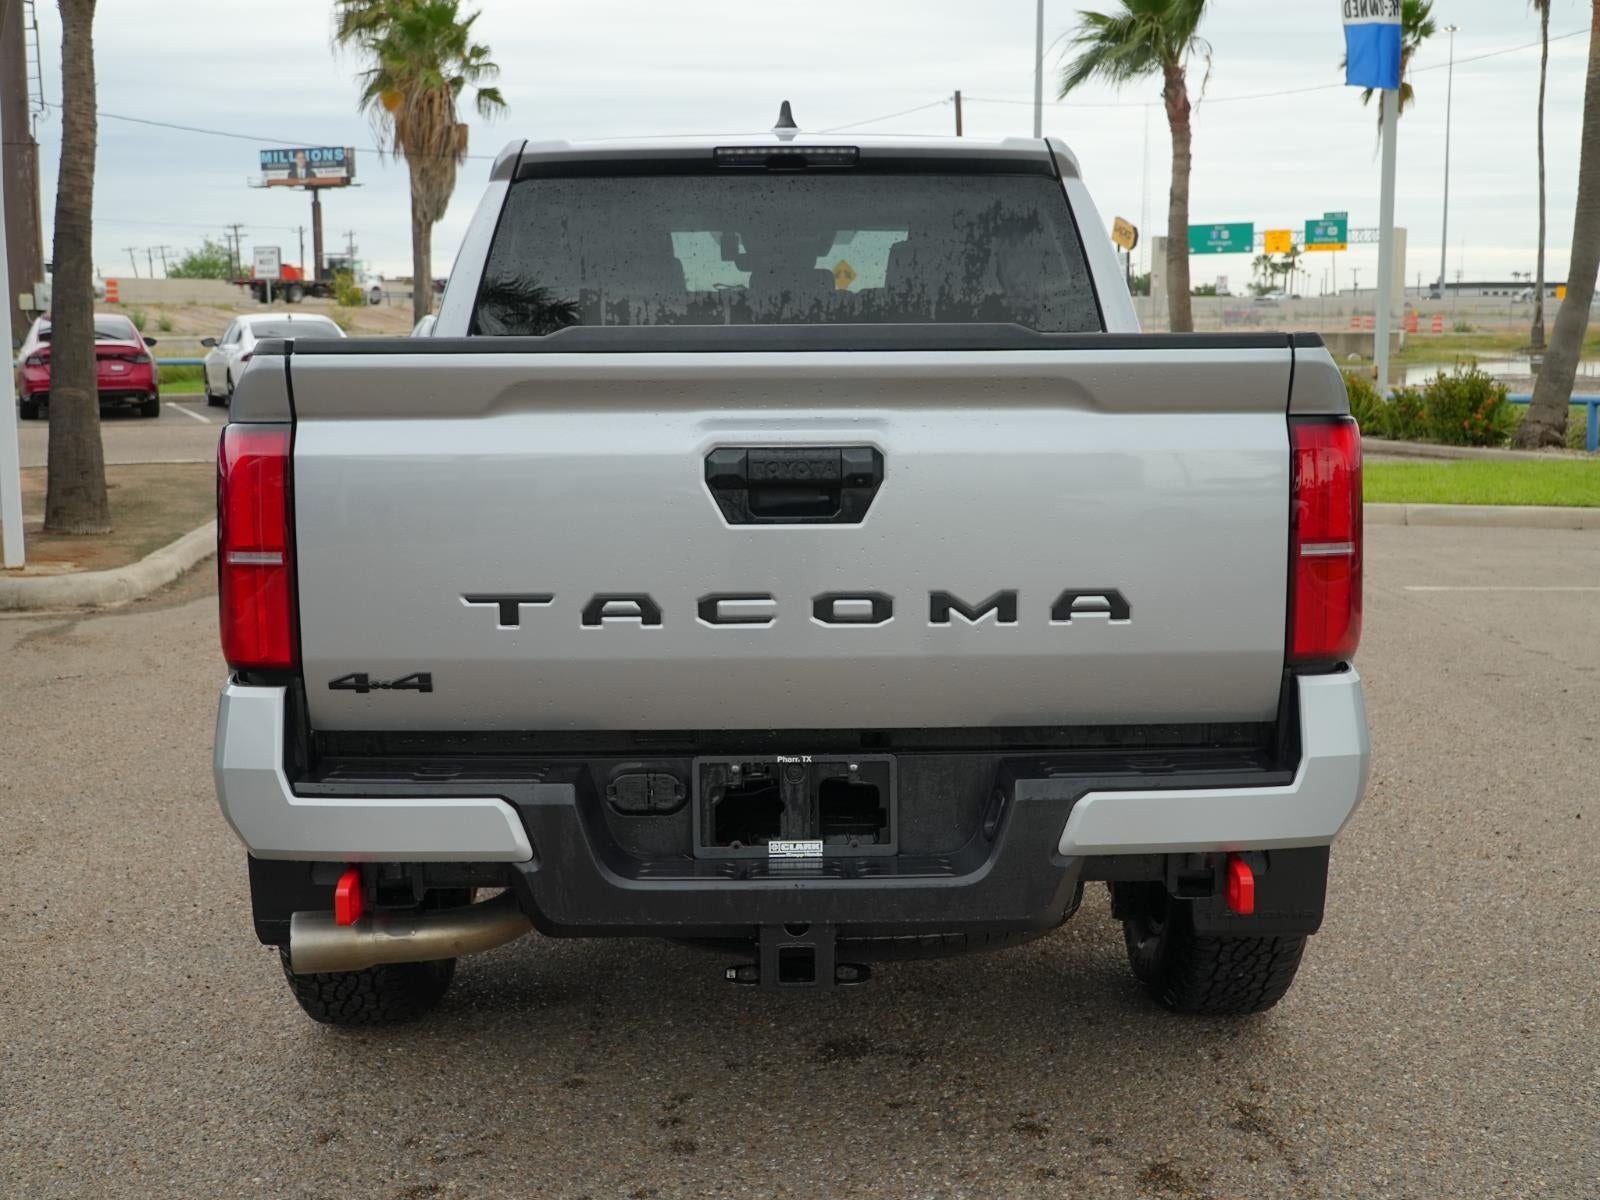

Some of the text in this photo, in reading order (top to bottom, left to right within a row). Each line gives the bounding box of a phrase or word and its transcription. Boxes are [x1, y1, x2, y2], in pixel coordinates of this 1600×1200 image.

[261, 148, 344, 162] MILLIONS
[751, 460, 837, 480] TOYOTA
[459, 589, 1132, 629] TACOMA
[801, 755, 812, 763] TX
[780, 843, 820, 851] CLARK
